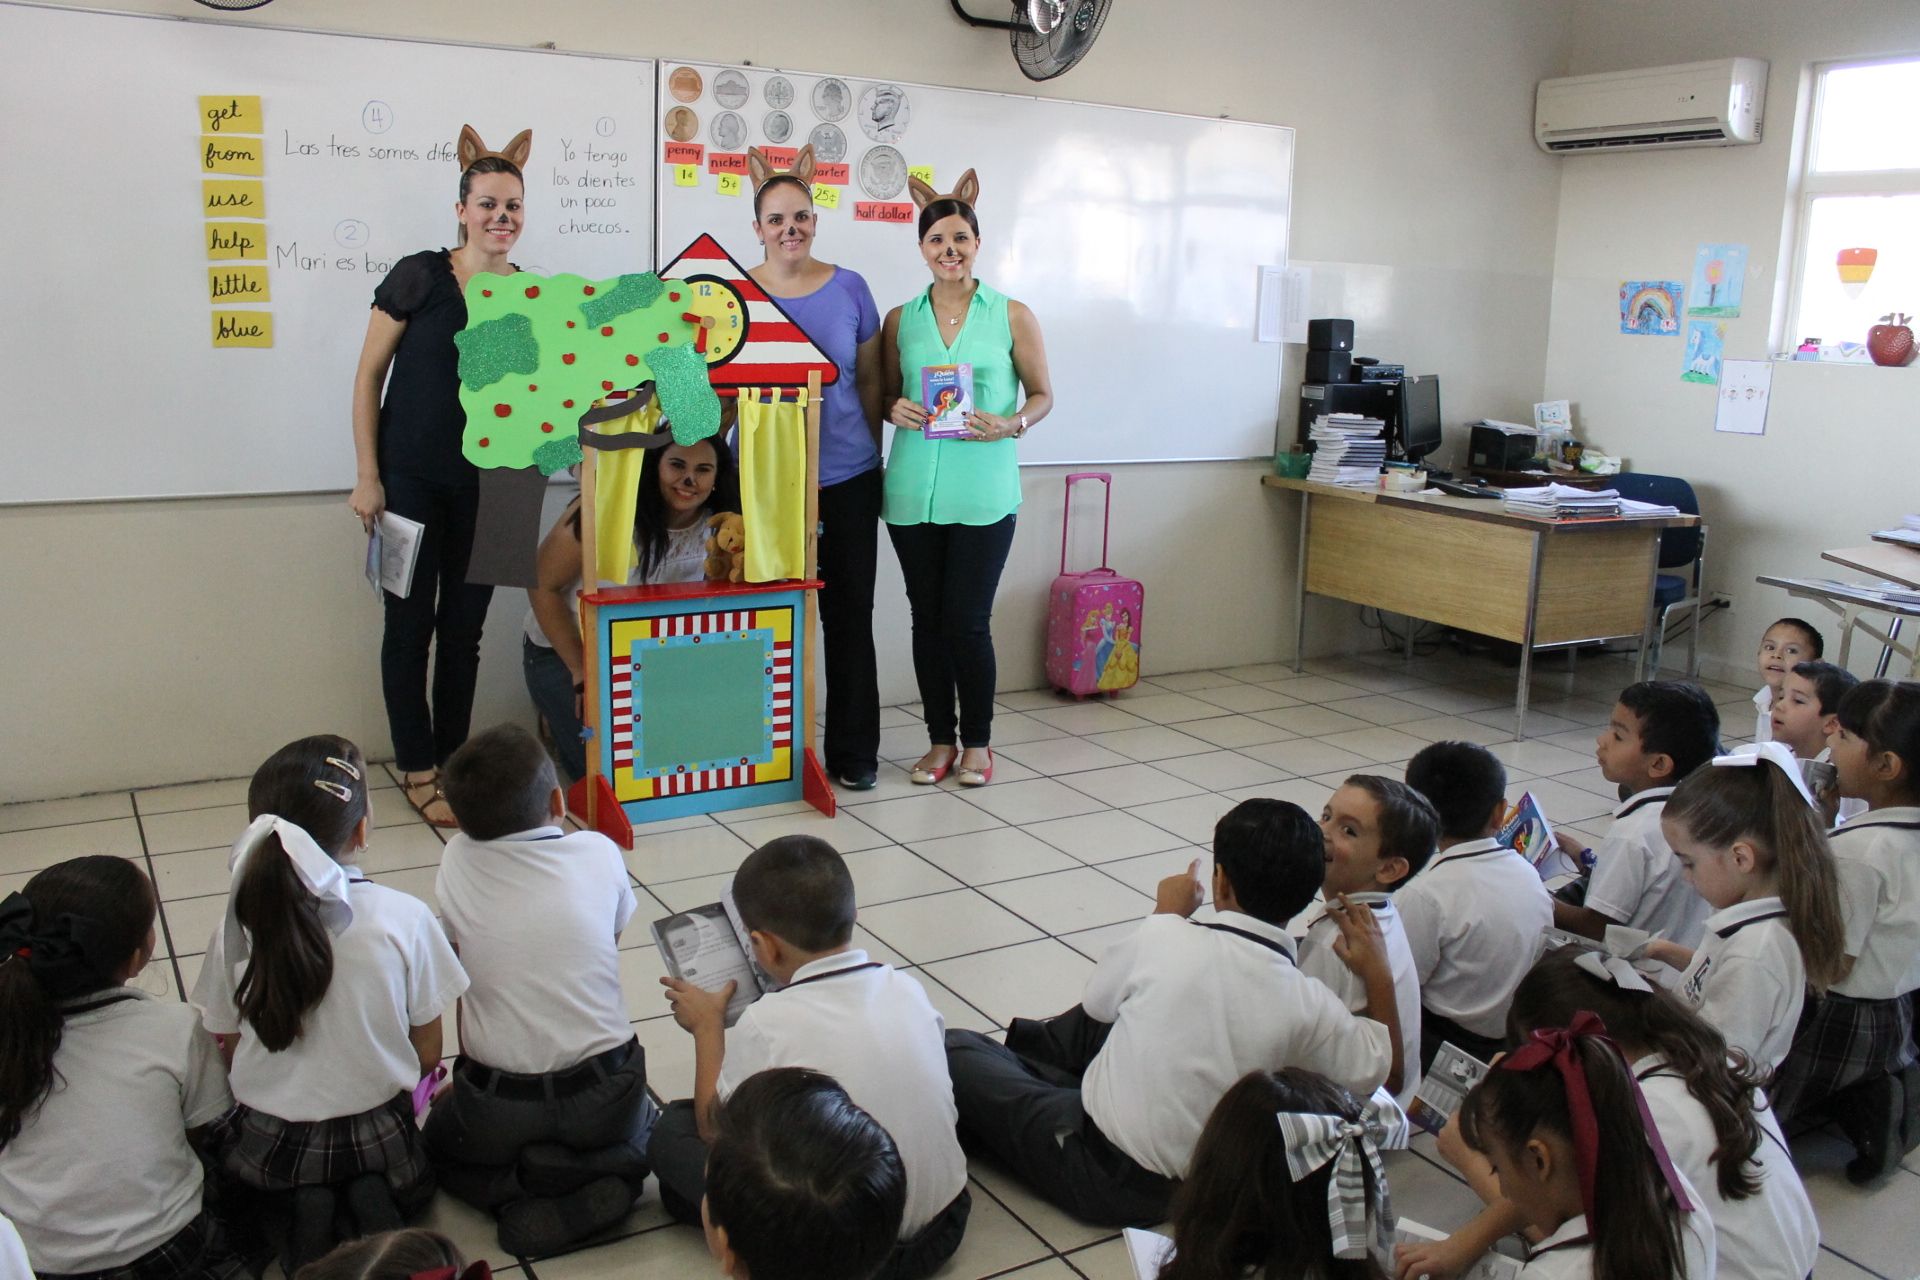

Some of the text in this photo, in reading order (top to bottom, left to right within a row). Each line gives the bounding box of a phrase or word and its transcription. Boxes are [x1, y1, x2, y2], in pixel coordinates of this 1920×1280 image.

[207, 99, 242, 132] get
[284, 129, 320, 157] Las
[326, 134, 361, 158] tres
[368, 147, 420, 161] somos
[560, 137, 628, 168] Yo tengo
[667, 146, 701, 160] penny
[205, 142, 256, 169] from
[710, 155, 747, 168] nickel
[552, 168, 636, 189] los dientes
[720, 177, 737, 190] 5¢
[208, 193, 254, 208] use
[814, 187, 837, 203] 25¢
[560, 197, 617, 215] un poco
[856, 204, 912, 220] half dollar
[558, 218, 631, 235] chuecos.
[210, 228, 255, 258] help
[276, 241, 326, 271] Mari
[336, 257, 357, 272] es
[212, 273, 263, 298] little
[700, 285, 711, 296] 12
[216, 316, 264, 341] blue
[730, 315, 738, 328] 3
